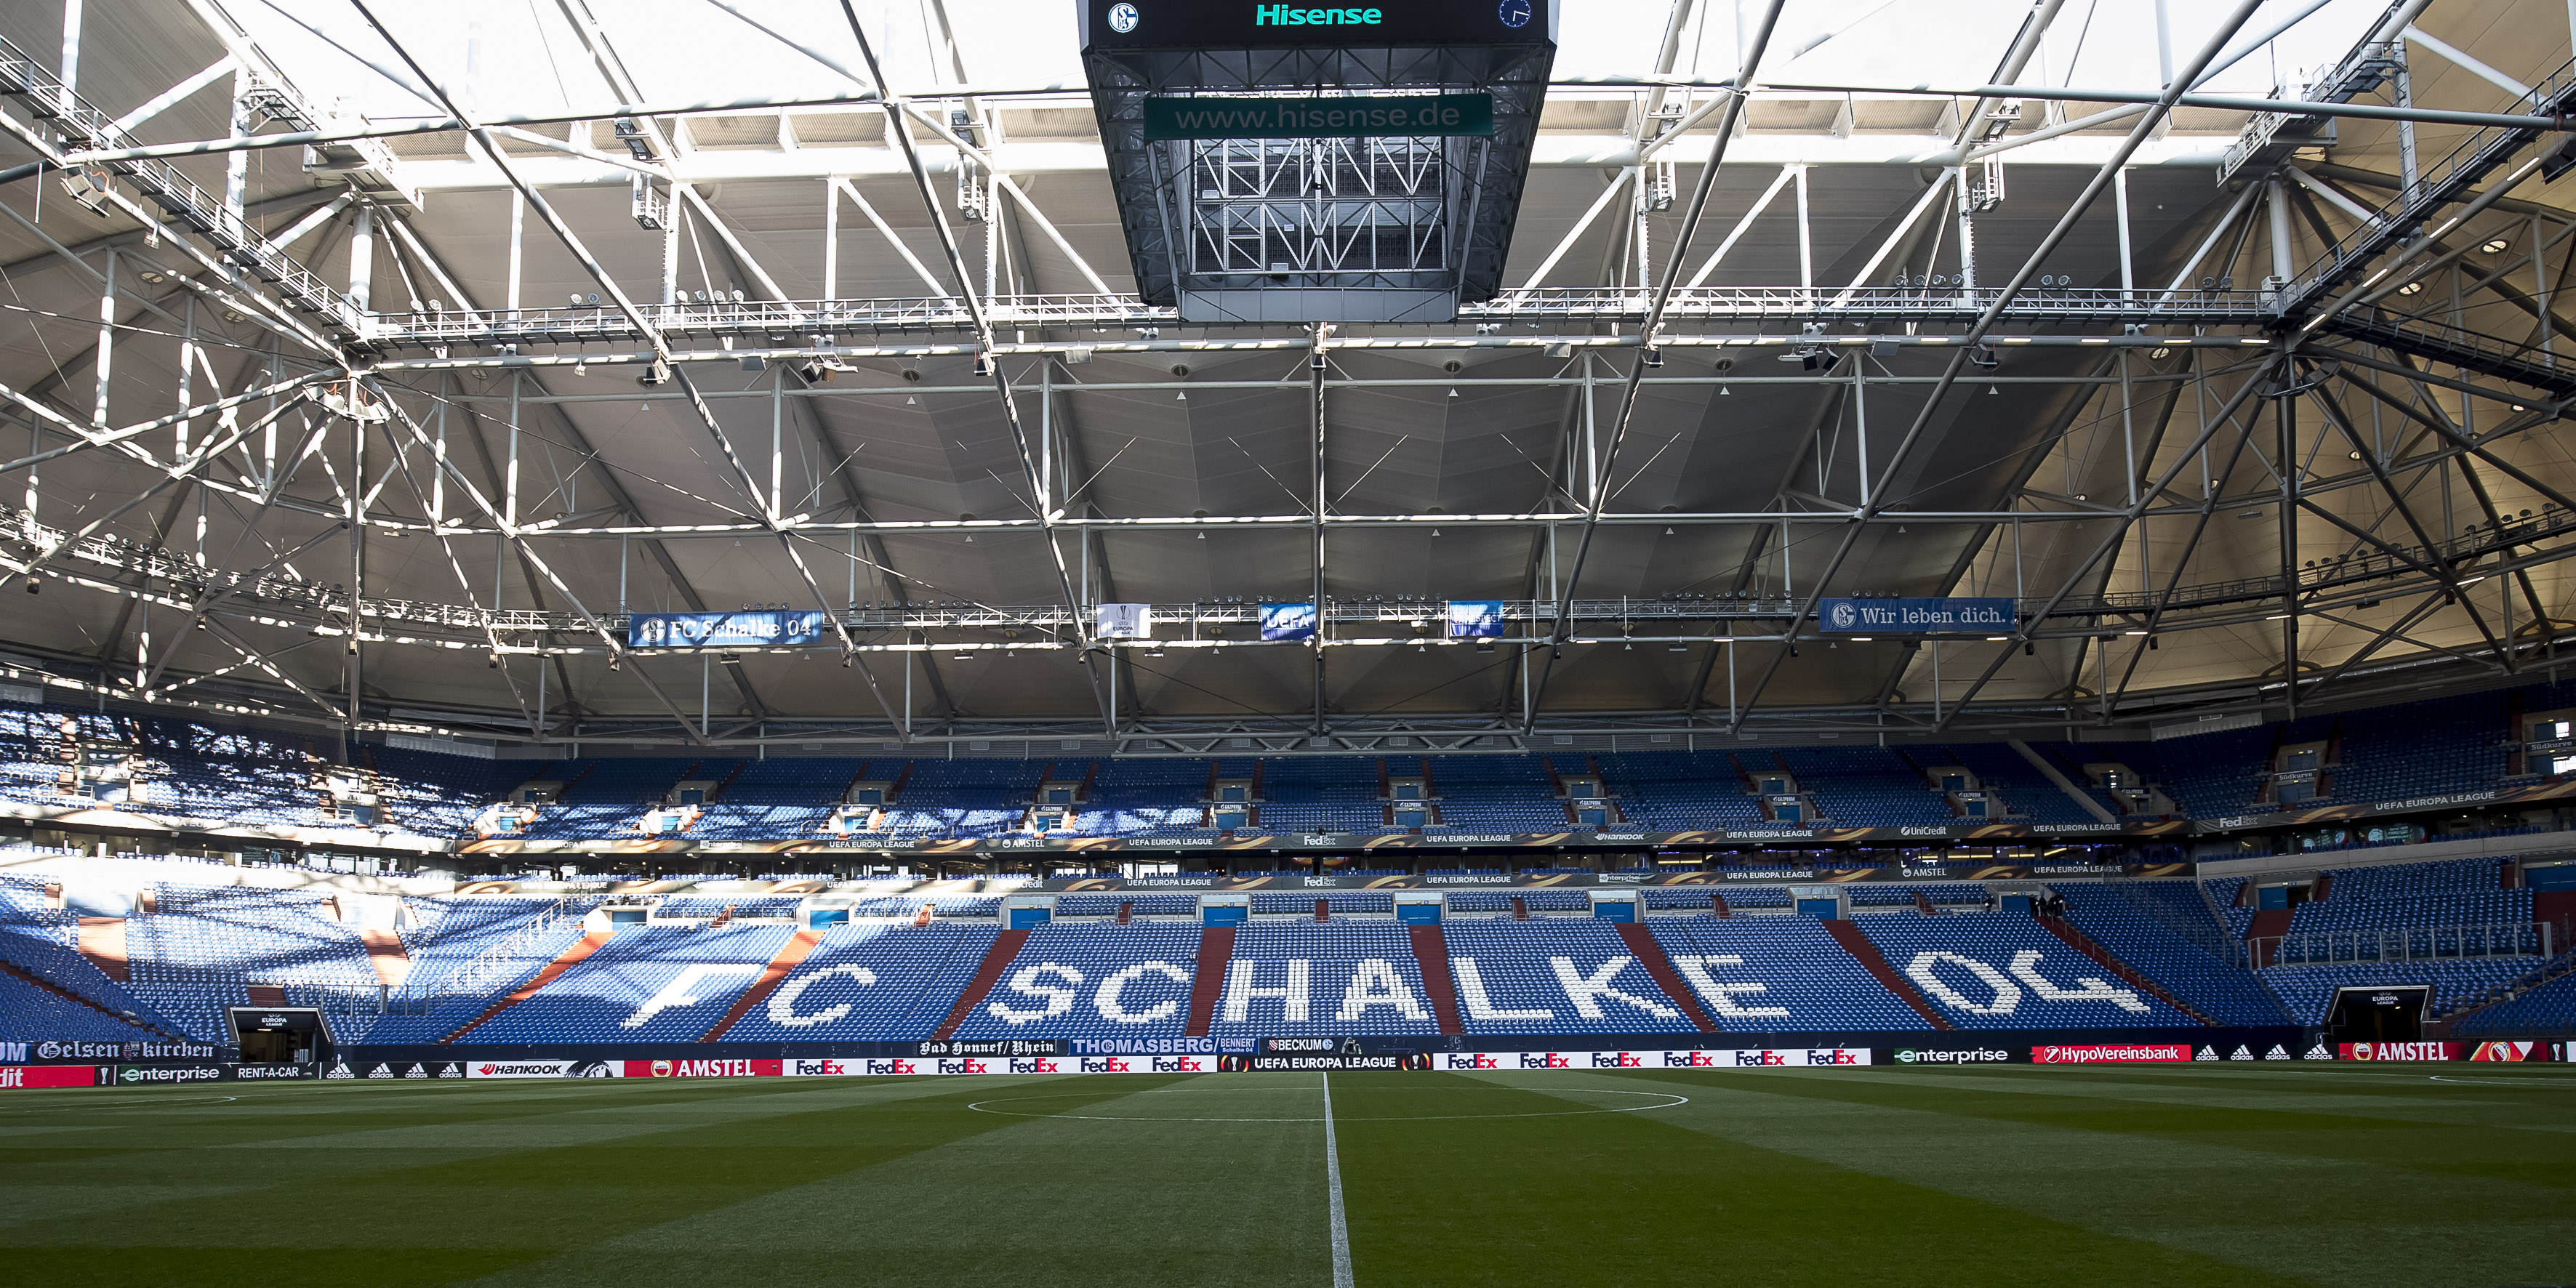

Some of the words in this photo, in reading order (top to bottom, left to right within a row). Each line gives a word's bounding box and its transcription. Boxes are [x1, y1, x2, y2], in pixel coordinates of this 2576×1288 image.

[1256, 4, 1381, 25] Hisense
[1175, 102, 1459, 129] www.hisense.de
[1267, 614, 1309, 628] UEFA
[1861, 608, 1896, 624] Wir
[1902, 608, 1954, 624] leben
[1961, 608, 2006, 624] dich.
[669, 620, 697, 638] FC
[702, 619, 780, 638] Schalke
[787, 619, 811, 637] 04
[2531, 741, 2572, 750] Südkurve
[2375, 802, 2404, 810] UEFA
[2406, 797, 2449, 807] EUROPA
[2451, 792, 2495, 802] LEAGUE
[2220, 816, 2258, 828] FedEx
[1911, 826, 1946, 835] UniCredit
[1304, 835, 1336, 845] FedEx
[1913, 868, 1946, 877] AMSTEL
[1304, 877, 1336, 886] FedEx
[620, 963, 877, 1030] FC
[987, 955, 1790, 1028] SCHALKE
[1906, 950, 2151, 1016] 04
[38, 1041, 120, 1058] Gelsen
[143, 1041, 213, 1058] kirchen
[920, 1041, 947, 1055] Bad
[1221, 1037, 1256, 1047] BENNERT
[1278, 1039, 1322, 1050] BECKUM
[1736, 1050, 1785, 1066] FedEx
[1807, 1050, 1856, 1065] FedEx
[1895, 1047, 2008, 1064] enterprise
[2062, 1046, 2178, 1063] HypoVereinsbank
[2377, 1042, 2449, 1060] AMSTEL
[867, 1059, 915, 1074] FedEx
[938, 1058, 987, 1074] FedEx
[1010, 1058, 1058, 1074] FedEx
[1080, 1058, 1129, 1072] FedEx
[1152, 1057, 1201, 1072] FedEx
[1254, 1058, 1289, 1068] UEFA
[1292, 1058, 1342, 1068] EUROPA
[1346, 1057, 1396, 1068] LEAGUE
[1448, 1053, 1497, 1068] FedEx
[1520, 1053, 1569, 1068] FedEx
[1592, 1052, 1641, 1067] FedEx
[1664, 1052, 1713, 1066] FedEx
[120, 1066, 219, 1083] enterprise
[238, 1067, 299, 1078] RENT-A-CAR
[676, 1059, 755, 1076] AMSTEL
[796, 1060, 845, 1075] FedEx
